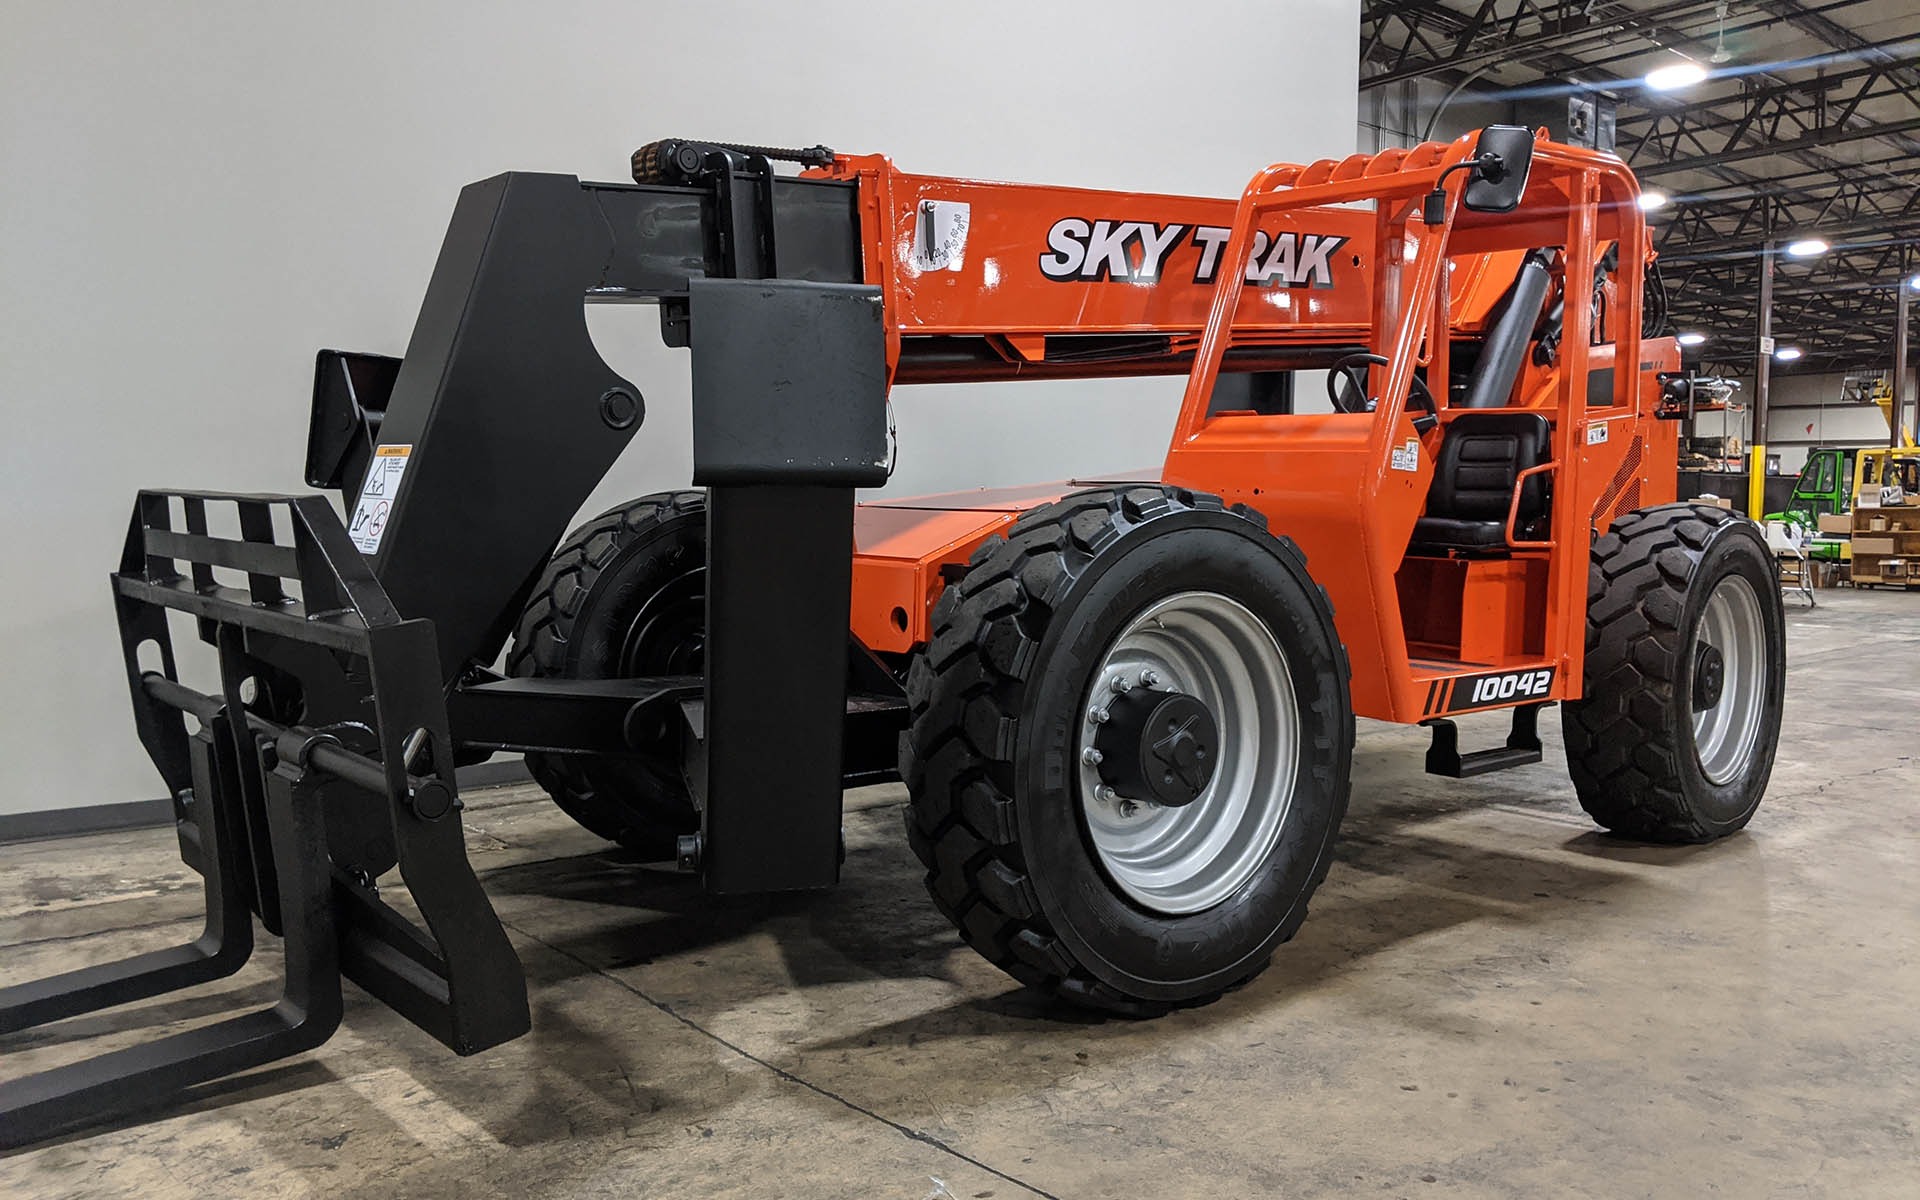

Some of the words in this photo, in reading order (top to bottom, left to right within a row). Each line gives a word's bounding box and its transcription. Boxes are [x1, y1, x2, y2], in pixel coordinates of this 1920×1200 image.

[1040, 217, 1188, 281] SKY
[1193, 226, 1345, 287] TRAK
[1471, 671, 1551, 702] 10042
